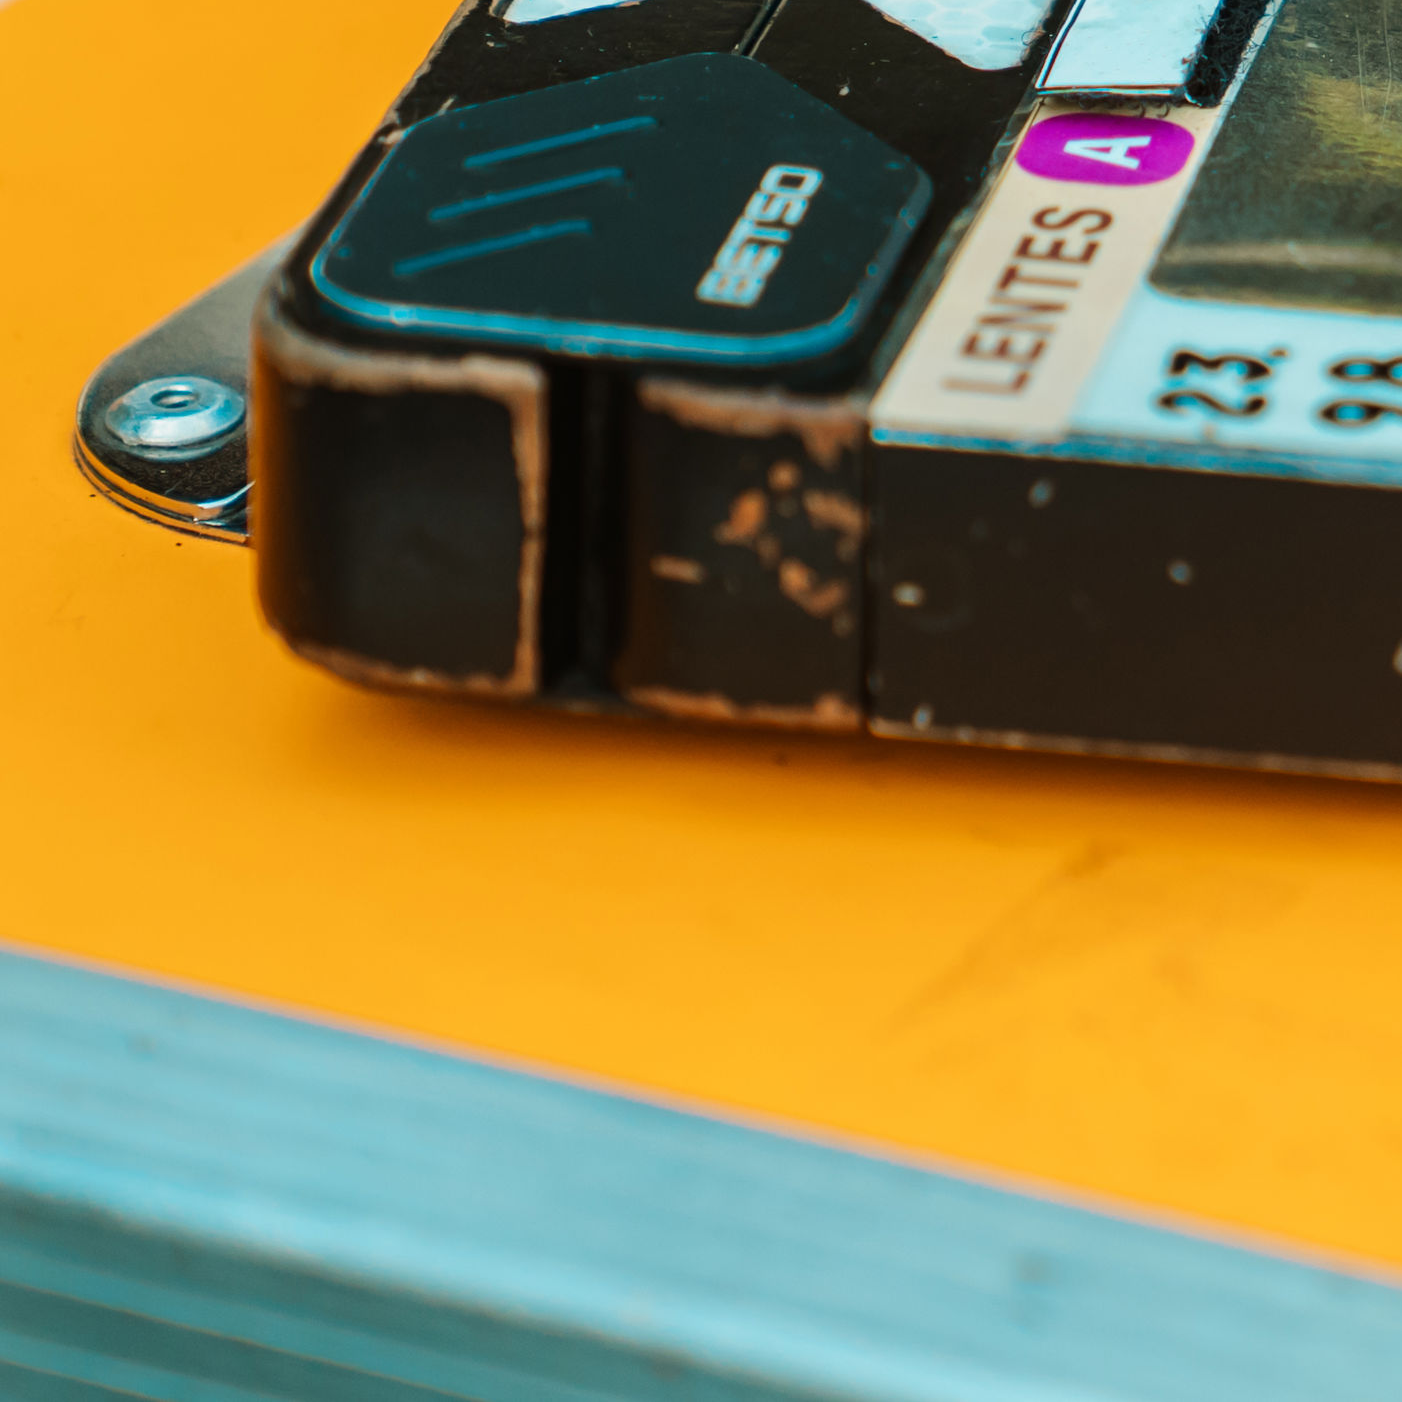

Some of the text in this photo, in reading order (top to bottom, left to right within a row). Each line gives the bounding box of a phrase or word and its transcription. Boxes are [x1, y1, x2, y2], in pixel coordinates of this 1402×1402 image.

[1063, 135, 1151, 169] A
[696, 164, 823, 308] BETSO
[940, 206, 1114, 398] LENTES
